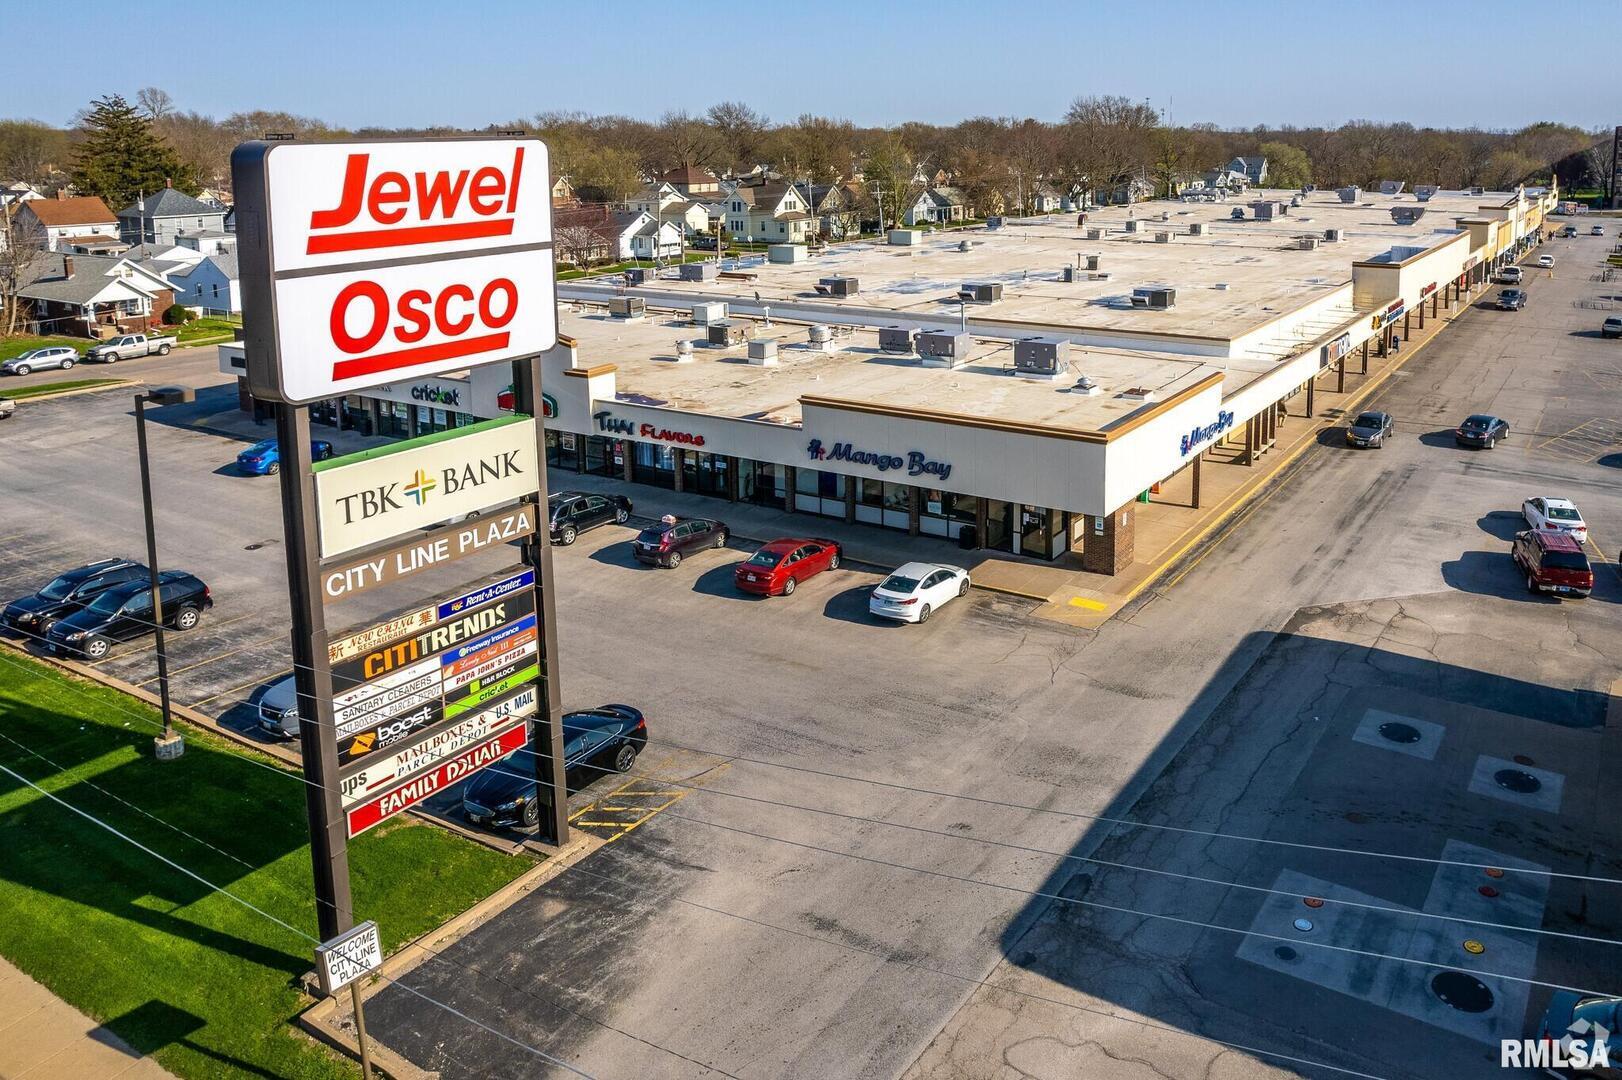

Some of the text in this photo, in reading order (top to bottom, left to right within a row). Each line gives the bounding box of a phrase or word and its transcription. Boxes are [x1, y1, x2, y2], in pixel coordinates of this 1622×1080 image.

[310, 147, 525, 229] Jewel
[330, 277, 518, 354] Osco
[411, 383, 461, 406] cricket
[826, 442, 952, 480] Mango Bay
[335, 449, 524, 525] TBK BANK
[326, 512, 531, 597] CITY LINE PLAZA
[348, 616, 414, 649] NEW CHINA
[357, 627, 408, 652] RESTAURANT
[456, 648, 526, 685] PAPA JOHN'S PIZZA
[481, 665, 515, 687] H&R BLOCK
[342, 695, 384, 720] SANITARY
[388, 676, 432, 701] CLEANERS
[335, 713, 378, 739] MAILBOXES
[389, 696, 415, 715] PARCEL
[377, 706, 432, 741] boost
[395, 720, 474, 767] MAILBOXES
[478, 714, 487, 726] &
[496, 703, 511, 719] U.S.
[514, 691, 534, 710] MAIL
[378, 731, 408, 749] mobile
[397, 725, 488, 778] PARCEL DEPOT
[380, 770, 440, 817] FAMILY
[327, 929, 376, 964] WELCOME
[330, 943, 376, 975] CITY LINE
[340, 958, 372, 983] PLAZA
